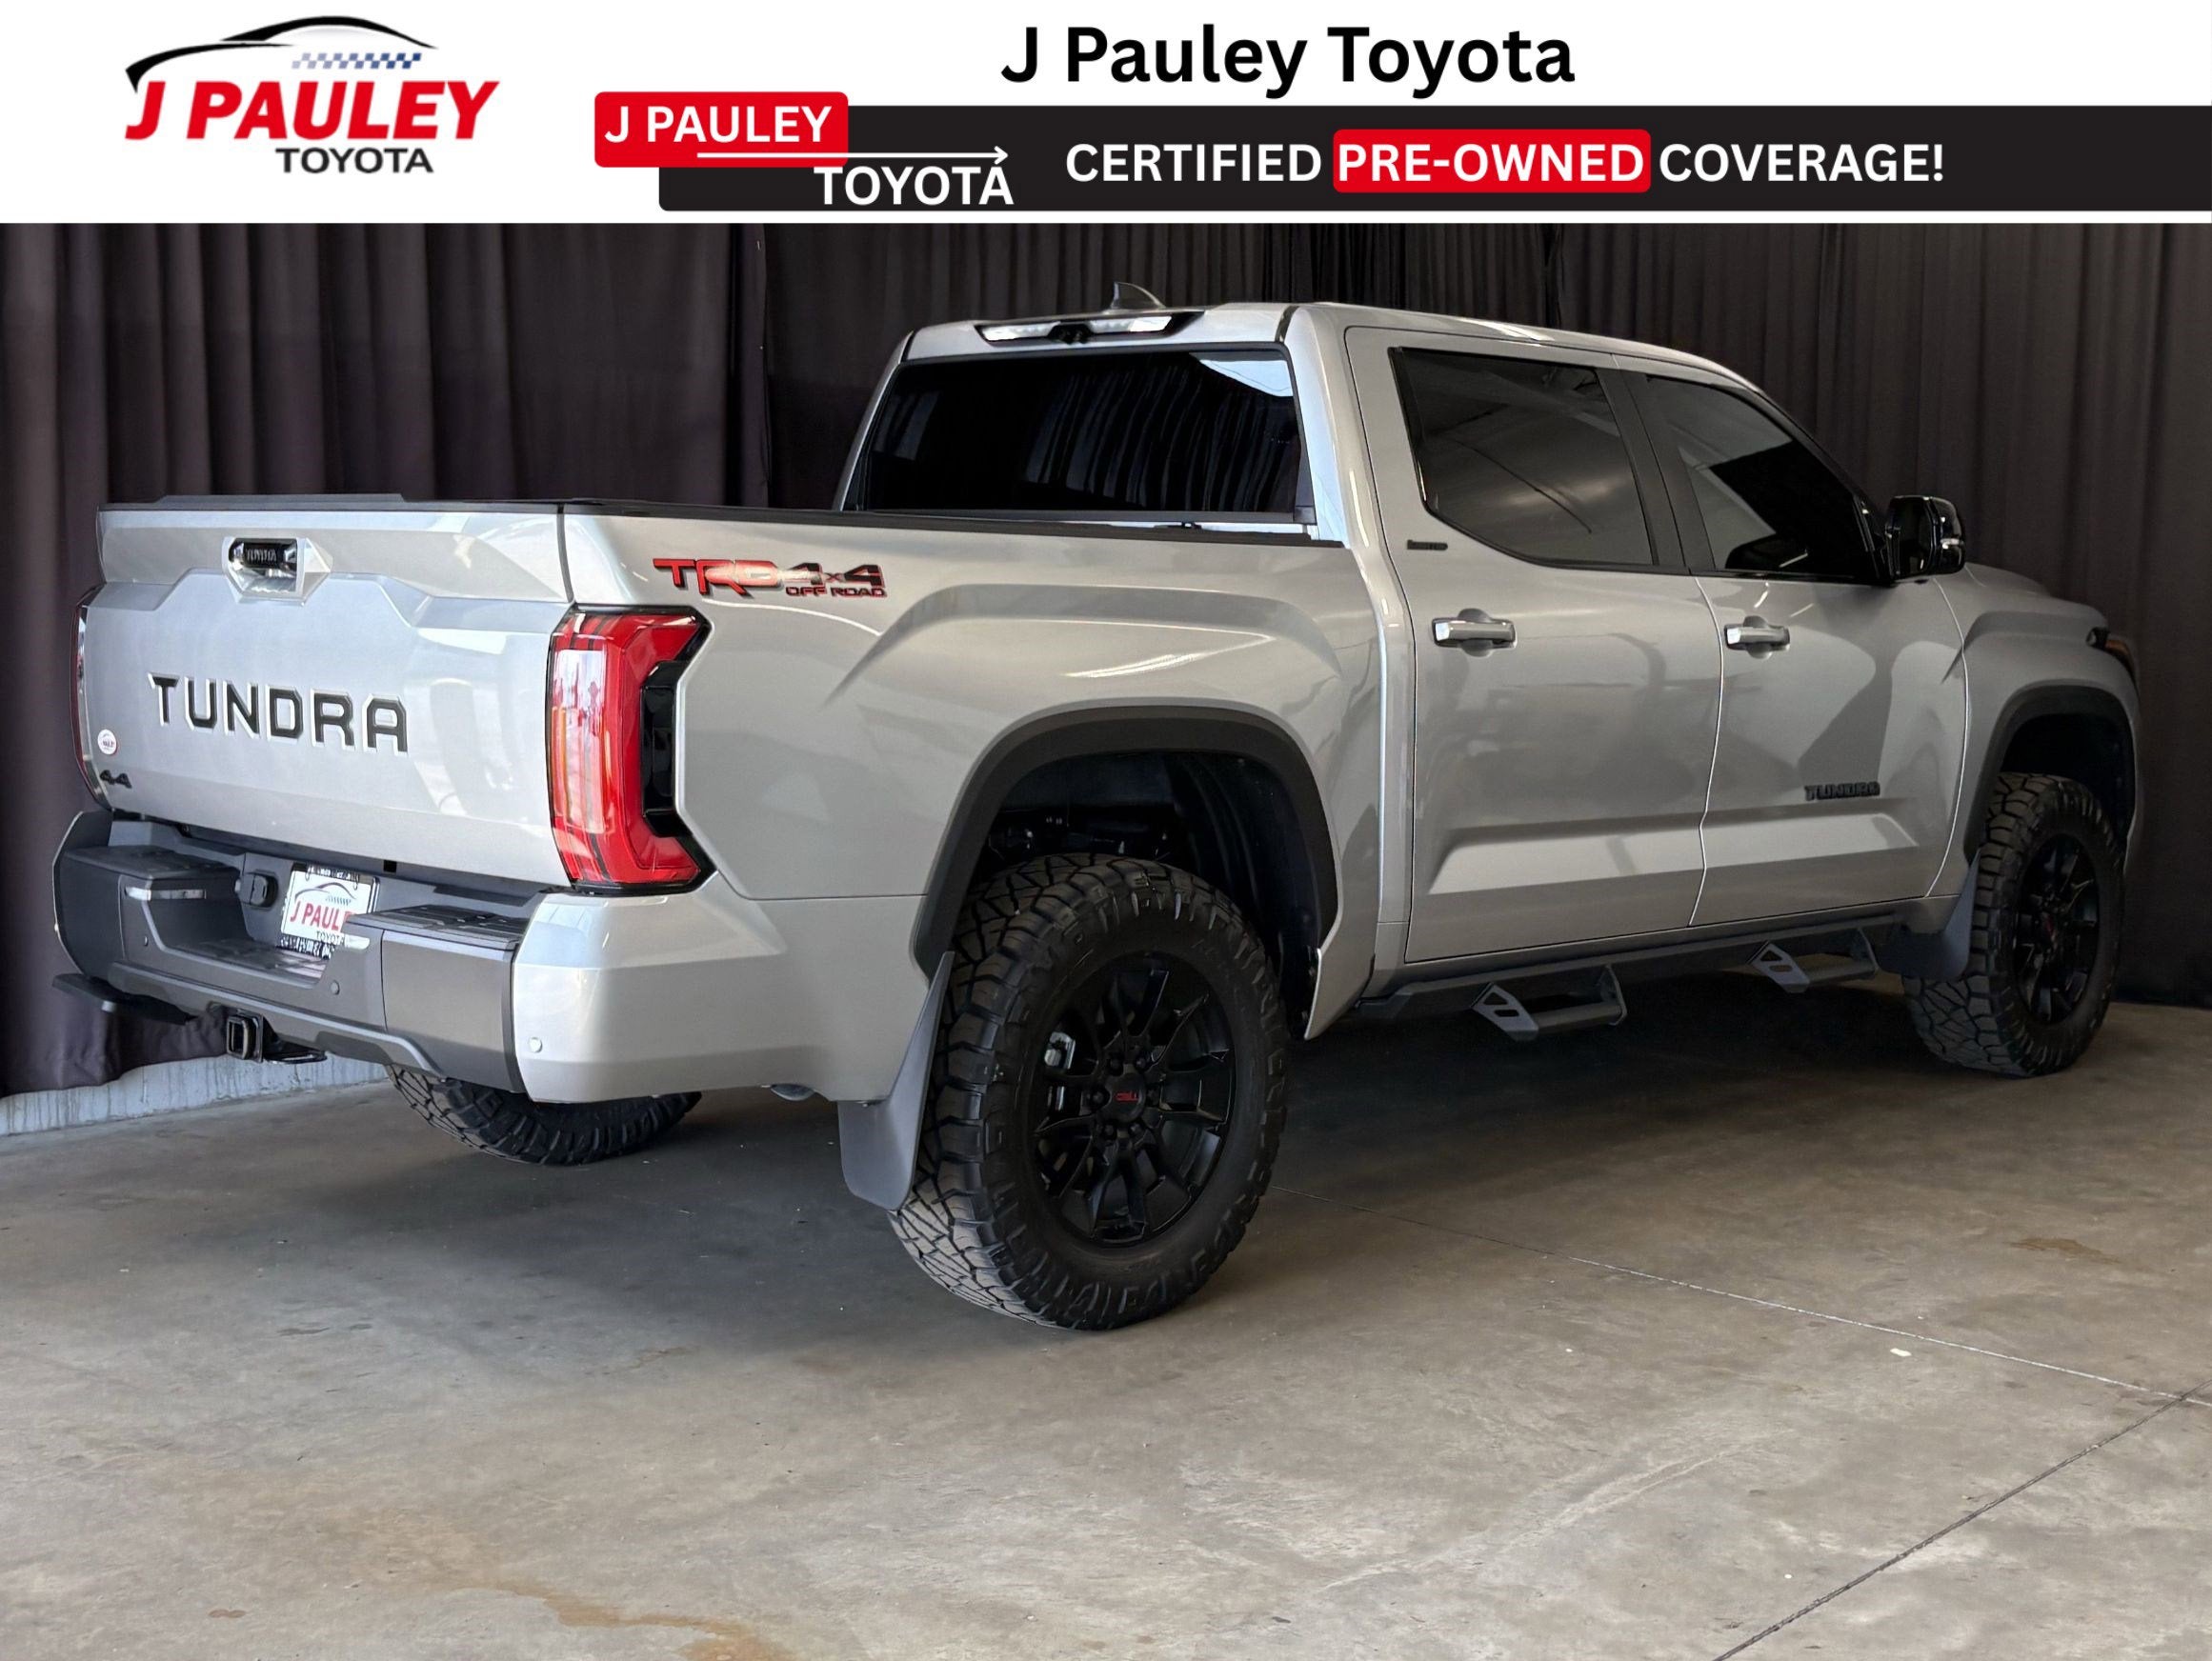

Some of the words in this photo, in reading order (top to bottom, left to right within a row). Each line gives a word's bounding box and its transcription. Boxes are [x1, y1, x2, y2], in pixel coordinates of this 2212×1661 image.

[653, 558, 781, 596] TRD
[785, 586, 827, 597] OFF
[830, 587, 887, 598] ROAD
[149, 673, 408, 756] TUNDRA
[1804, 781, 1880, 801] TUNDRA
